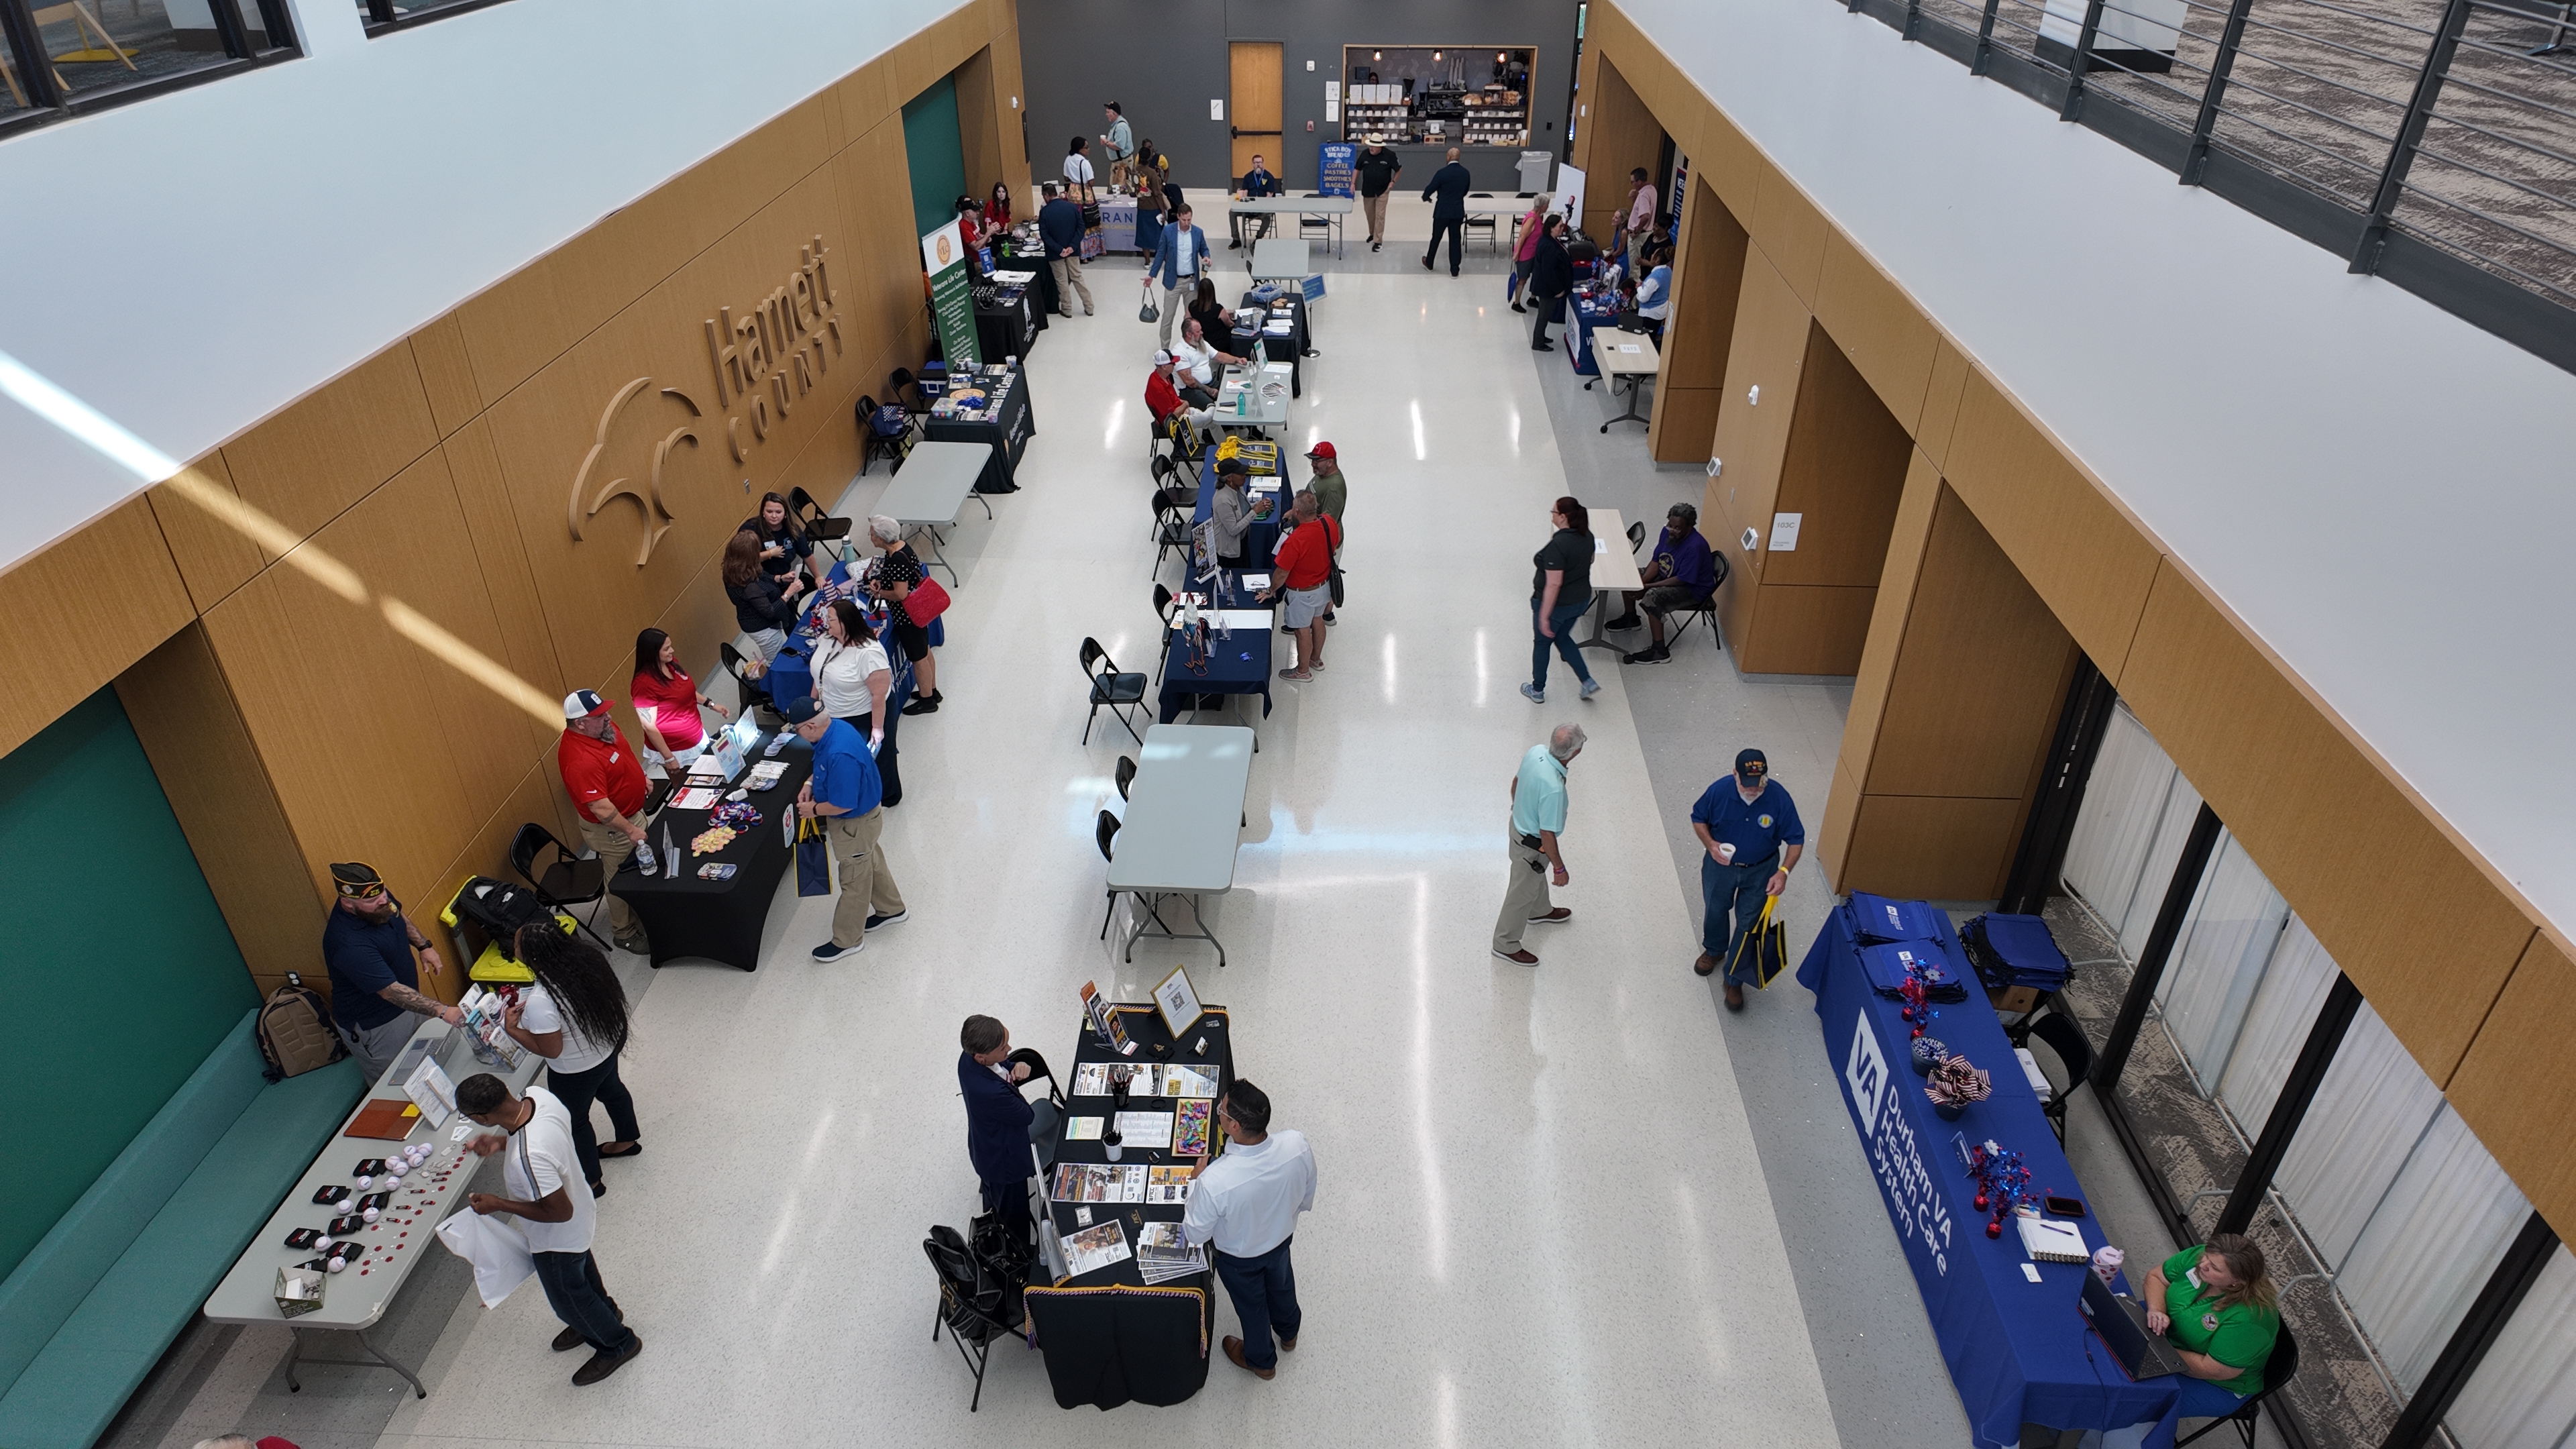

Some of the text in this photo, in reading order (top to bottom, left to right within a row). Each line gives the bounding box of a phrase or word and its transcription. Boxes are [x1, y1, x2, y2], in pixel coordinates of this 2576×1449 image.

[706, 234, 837, 407] Harnett
[729, 313, 843, 464] COUNTY
[1857, 1030, 1878, 1117] VA
[1875, 1135, 1913, 1240] System
[1881, 1109, 1947, 1277] Health Care
[1888, 1084, 1951, 1249] Durham VA
